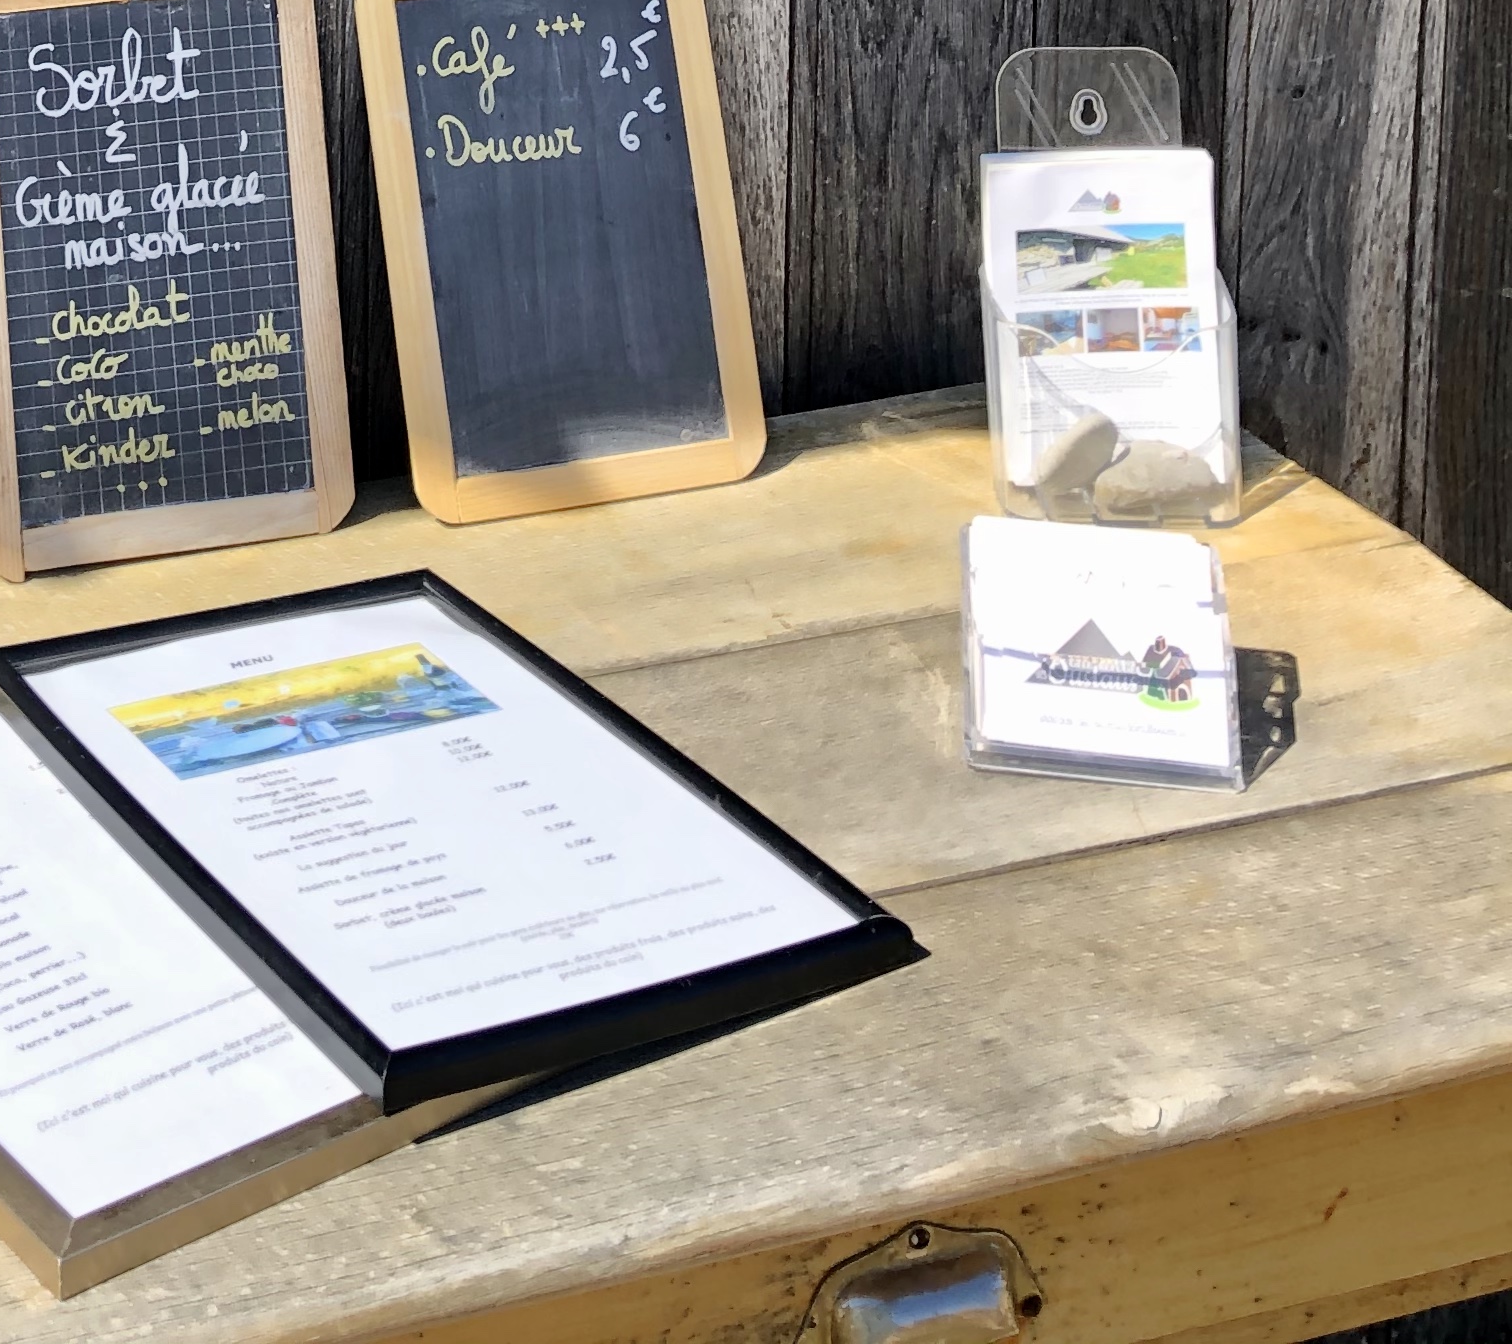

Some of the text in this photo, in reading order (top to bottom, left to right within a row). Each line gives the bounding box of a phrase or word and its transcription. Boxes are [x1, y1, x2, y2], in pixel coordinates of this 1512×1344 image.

[29, 27, 201, 119] Sorbet
[432, 24, 516, 114] Café
[438, 114, 583, 167] Douceur
[218, 392, 296, 431] melon
[61, 427, 176, 473] Kinder
[230, 654, 275, 670] MENU
[4, 1017, 38, 1032] Verre
[56, 996, 90, 1012] Rouge
[16, 1036, 51, 1051] Verre
